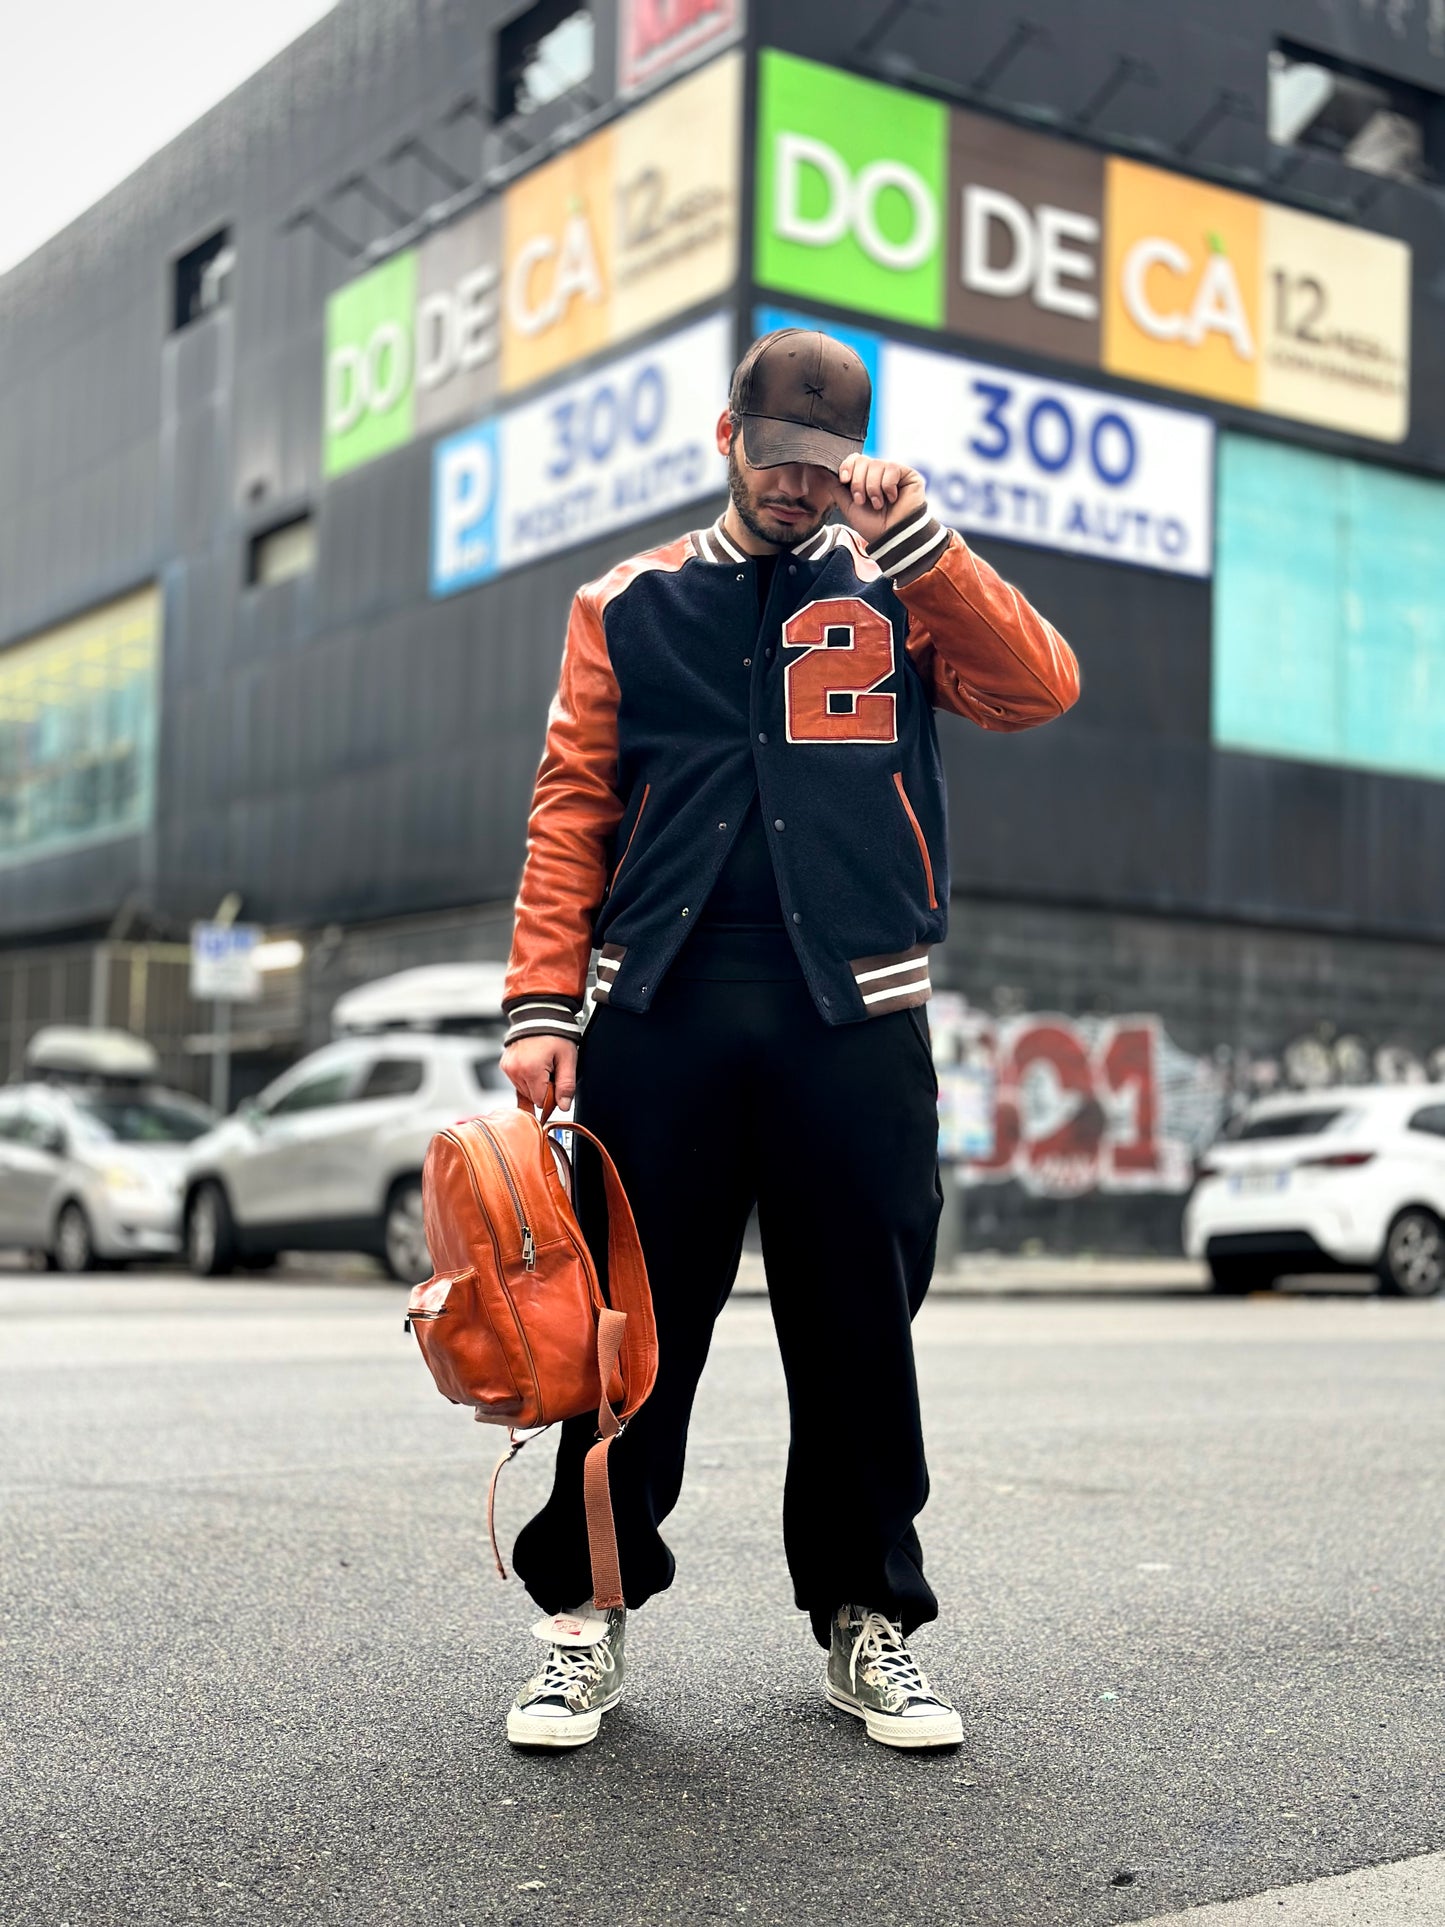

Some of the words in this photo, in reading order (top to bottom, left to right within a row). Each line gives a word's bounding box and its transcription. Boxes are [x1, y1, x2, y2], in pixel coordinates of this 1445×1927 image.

[773, 131, 940, 271] DO
[960, 184, 1099, 320] DE
[327, 324, 411, 434] DO
[417, 264, 500, 391] DE
[1273, 266, 1327, 345] 12
[546, 364, 666, 479] 300
[967, 378, 1138, 489] 300
[437, 440, 492, 580] P
[1064, 498, 1189, 557] AUTO
[782, 597, 898, 744] 2
